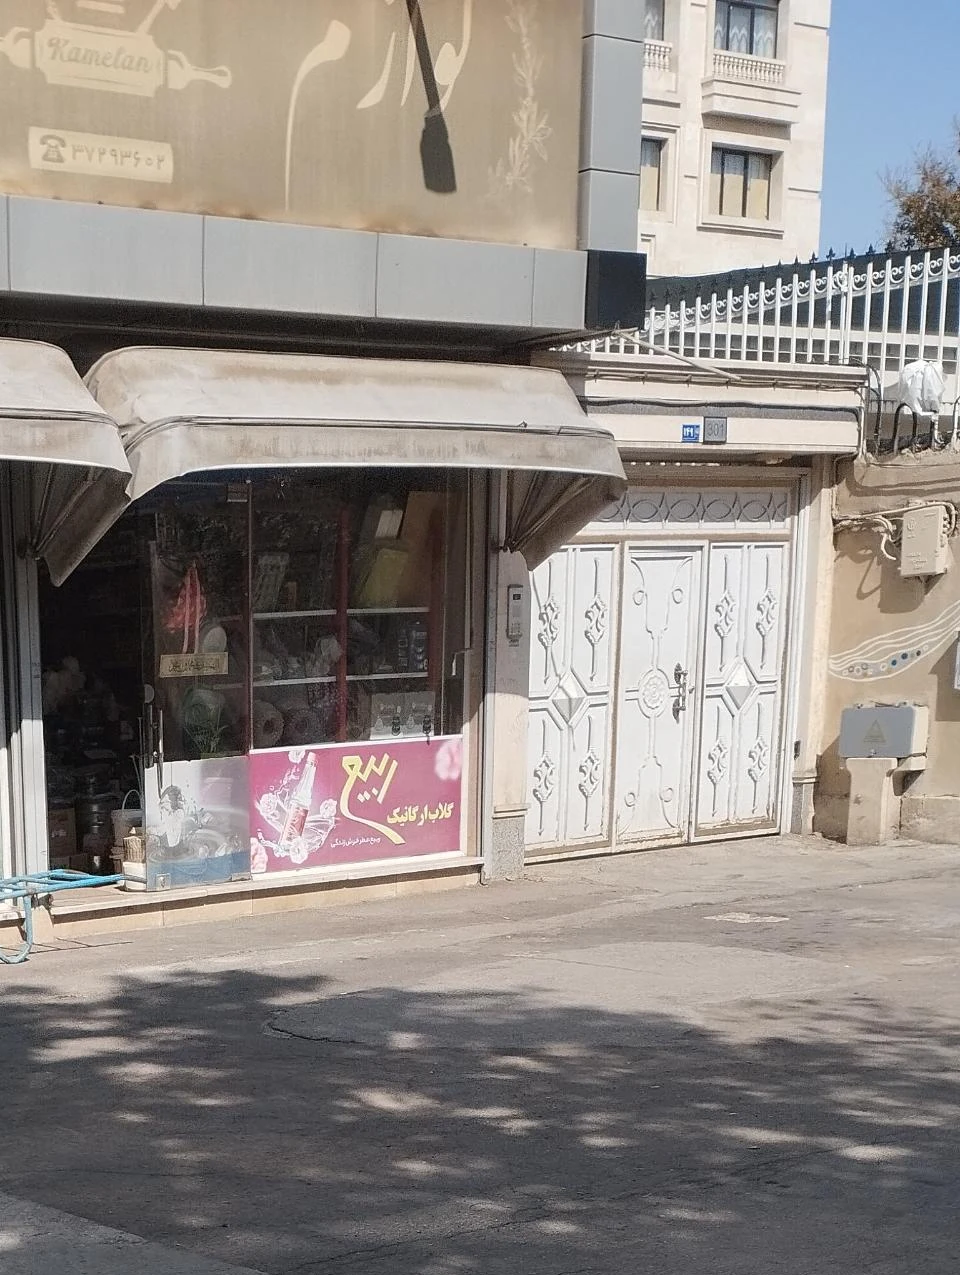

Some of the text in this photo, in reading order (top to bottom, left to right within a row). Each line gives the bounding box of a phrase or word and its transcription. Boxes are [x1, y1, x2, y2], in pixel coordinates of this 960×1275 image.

[47, 37, 152, 74] Kamelan
[340, 753, 406, 845] ربیع
[428, 802, 455, 823] گلاب
